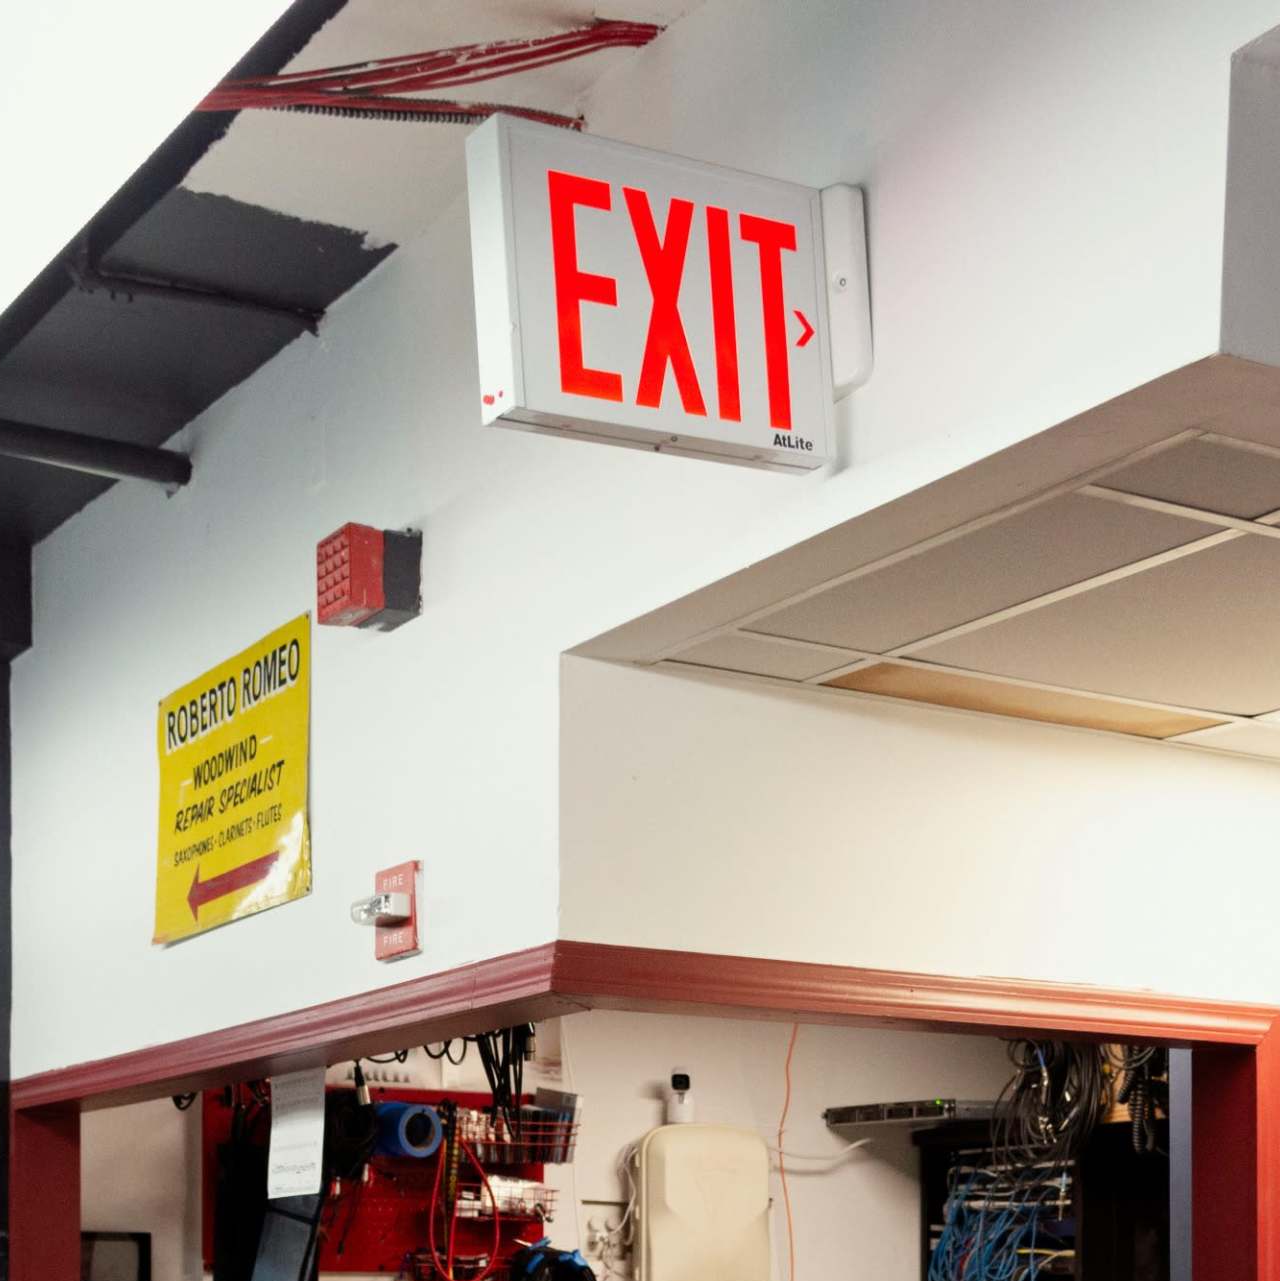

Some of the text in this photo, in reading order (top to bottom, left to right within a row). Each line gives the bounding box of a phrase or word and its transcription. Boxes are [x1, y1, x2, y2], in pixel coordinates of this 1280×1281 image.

[547, 168, 797, 430] EXIT
[772, 432, 814, 453] AtLite
[167, 638, 300, 750] ROBERTO ROMEO
[193, 734, 257, 790] WOODWIND
[175, 760, 285, 834] REPAIR SPECIALIST
[174, 802, 282, 867] SAXOPHONES CLARINETS FLUTES
[383, 873, 404, 890] FIRE
[383, 931, 403, 947] FIRE
